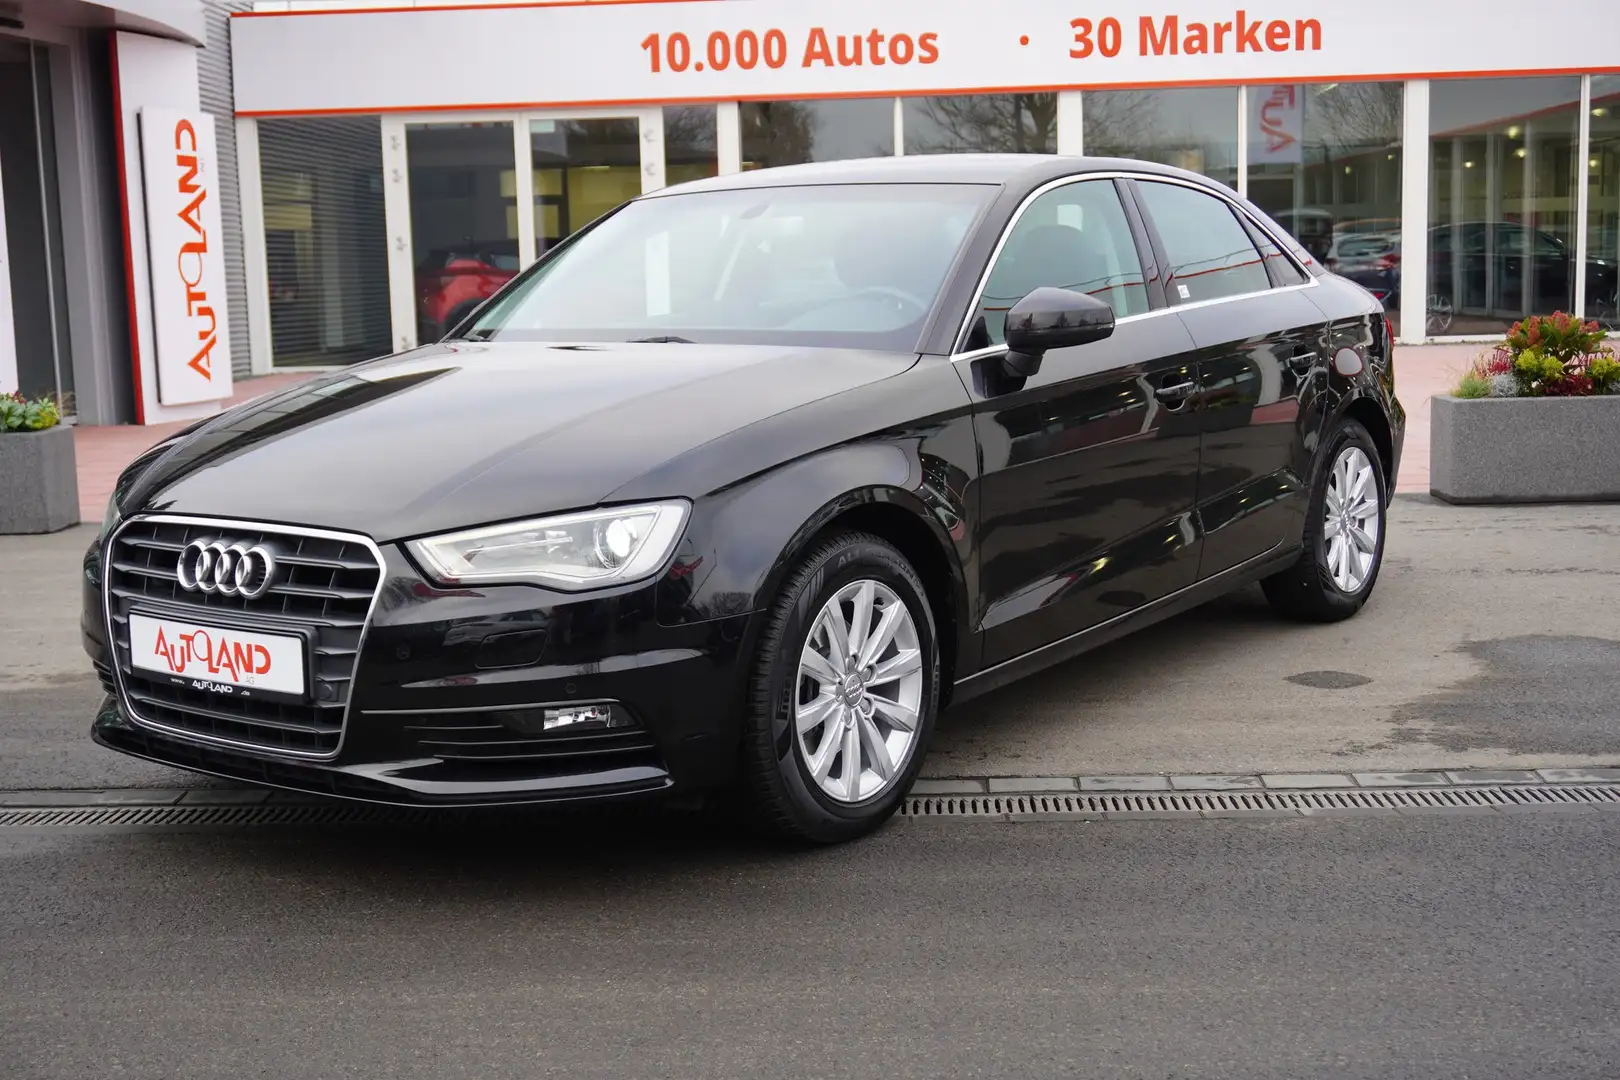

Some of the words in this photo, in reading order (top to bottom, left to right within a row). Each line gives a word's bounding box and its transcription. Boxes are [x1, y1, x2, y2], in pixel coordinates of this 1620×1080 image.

[641, 28, 787, 73] 10.000
[801, 27, 939, 68] Autos
[1069, 17, 1122, 59] 30
[1138, 10, 1321, 57] Marken
[175, 119, 217, 382] AUTOLAND
[154, 626, 272, 683] AUTOLAND
